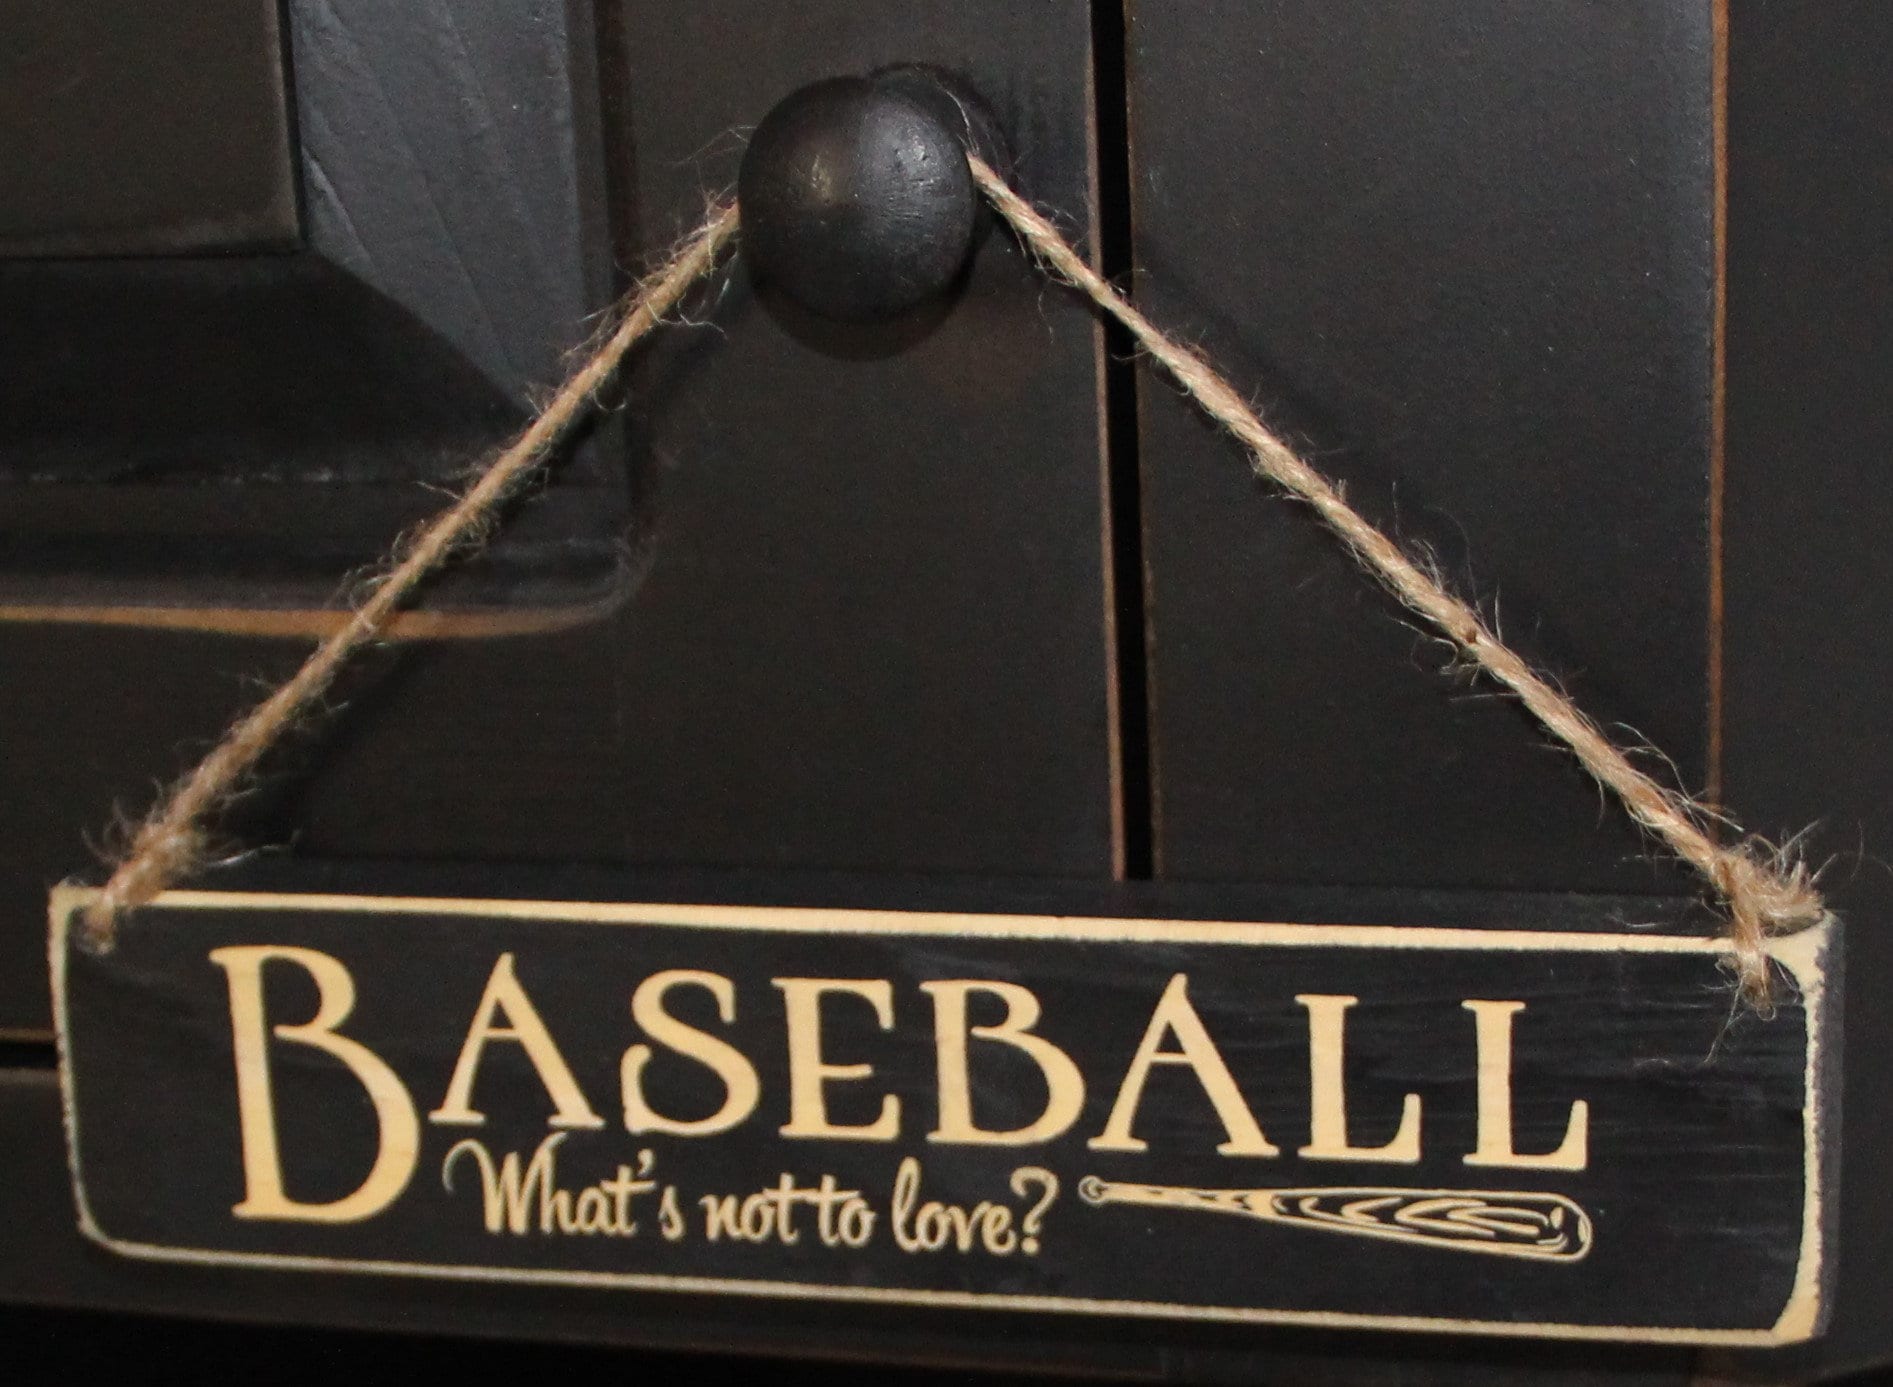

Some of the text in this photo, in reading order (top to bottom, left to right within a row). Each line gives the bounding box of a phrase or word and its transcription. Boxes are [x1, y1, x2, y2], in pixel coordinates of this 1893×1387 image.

[208, 944, 1589, 1224] BASEBALL
[442, 1130, 1060, 1256] What's not to love?
